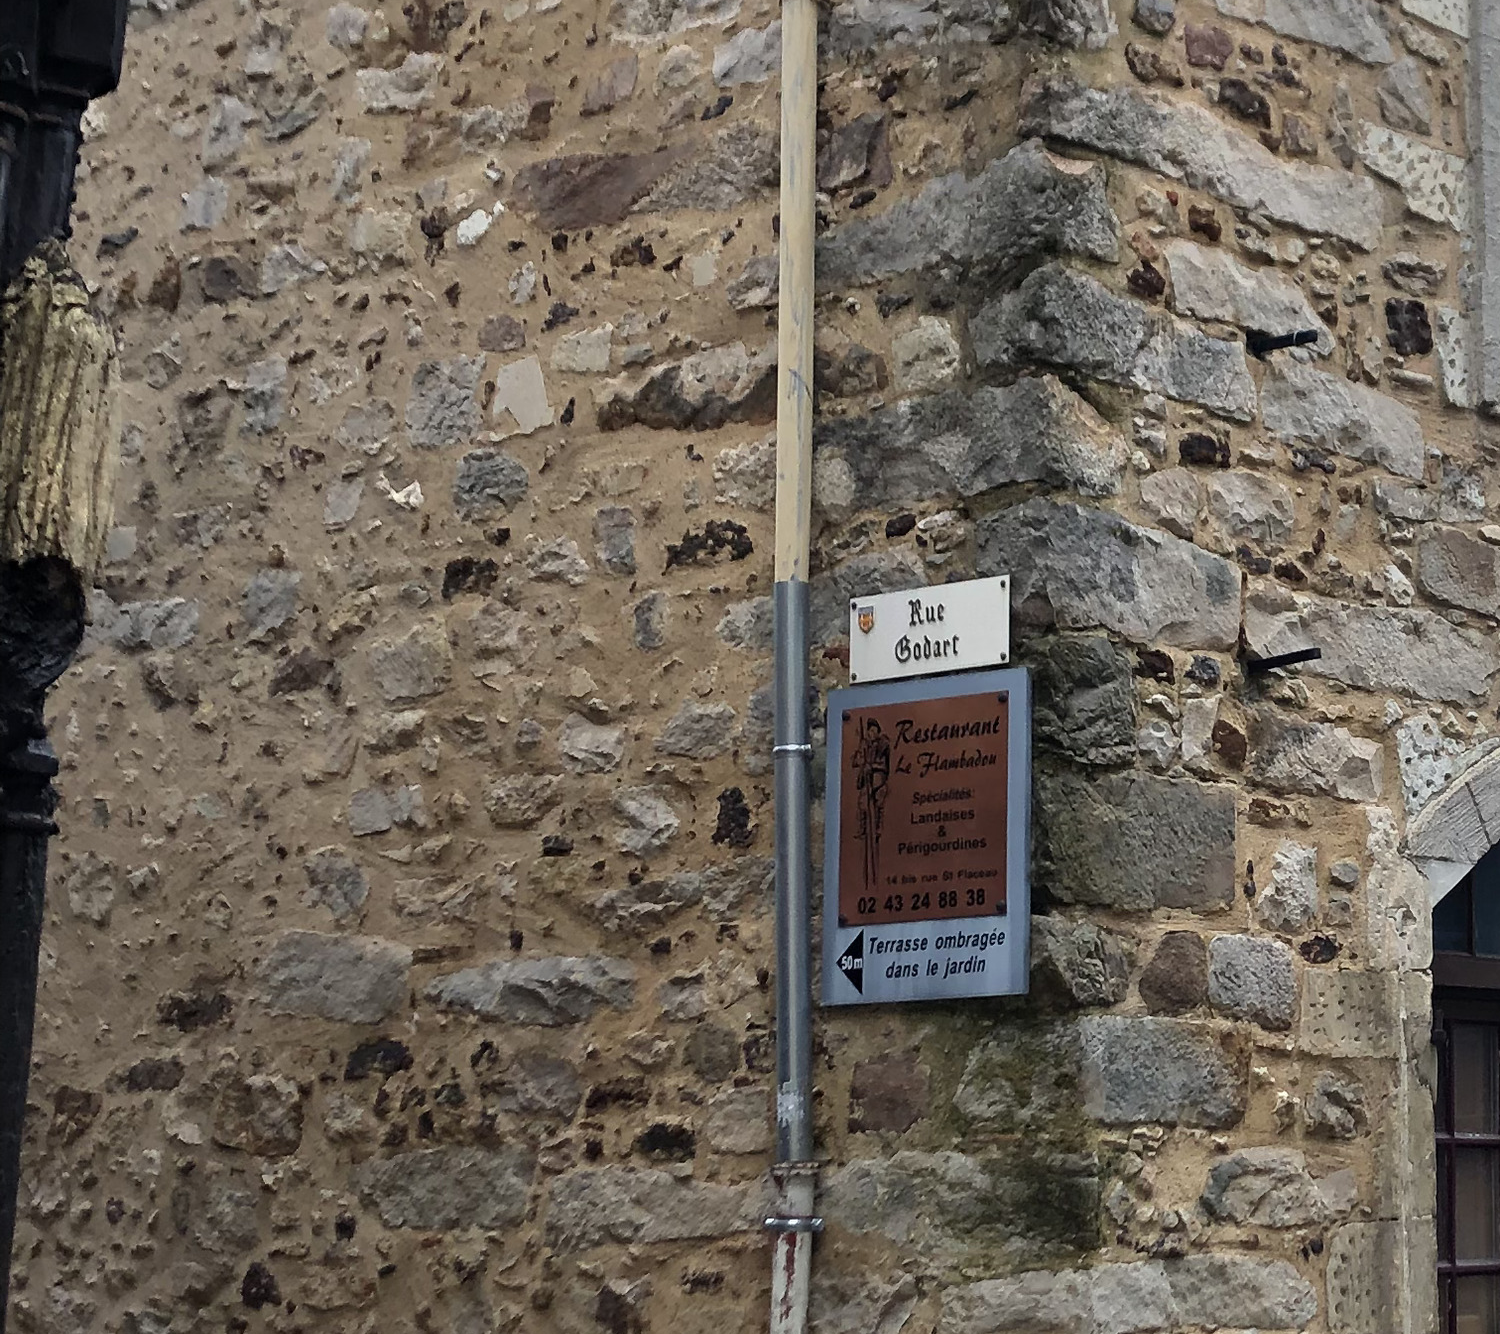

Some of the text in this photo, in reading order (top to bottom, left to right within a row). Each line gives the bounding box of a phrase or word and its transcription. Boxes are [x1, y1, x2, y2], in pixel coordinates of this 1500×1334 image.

[908, 598, 945, 627] Rue
[894, 634, 960, 663] Godart
[894, 715, 1000, 749] Restaurant
[895, 749, 997, 778] Le Flambadou
[910, 809, 975, 825] Landaises
[937, 825, 947, 837] &
[898, 836, 988, 856] Périgourdines
[921, 872, 938, 883] rue
[943, 870, 954, 882] St
[857, 888, 986, 914] 02 43 24 88 38
[869, 927, 1006, 955] Terrasse ombragée
[885, 955, 987, 979] dans le jardin
